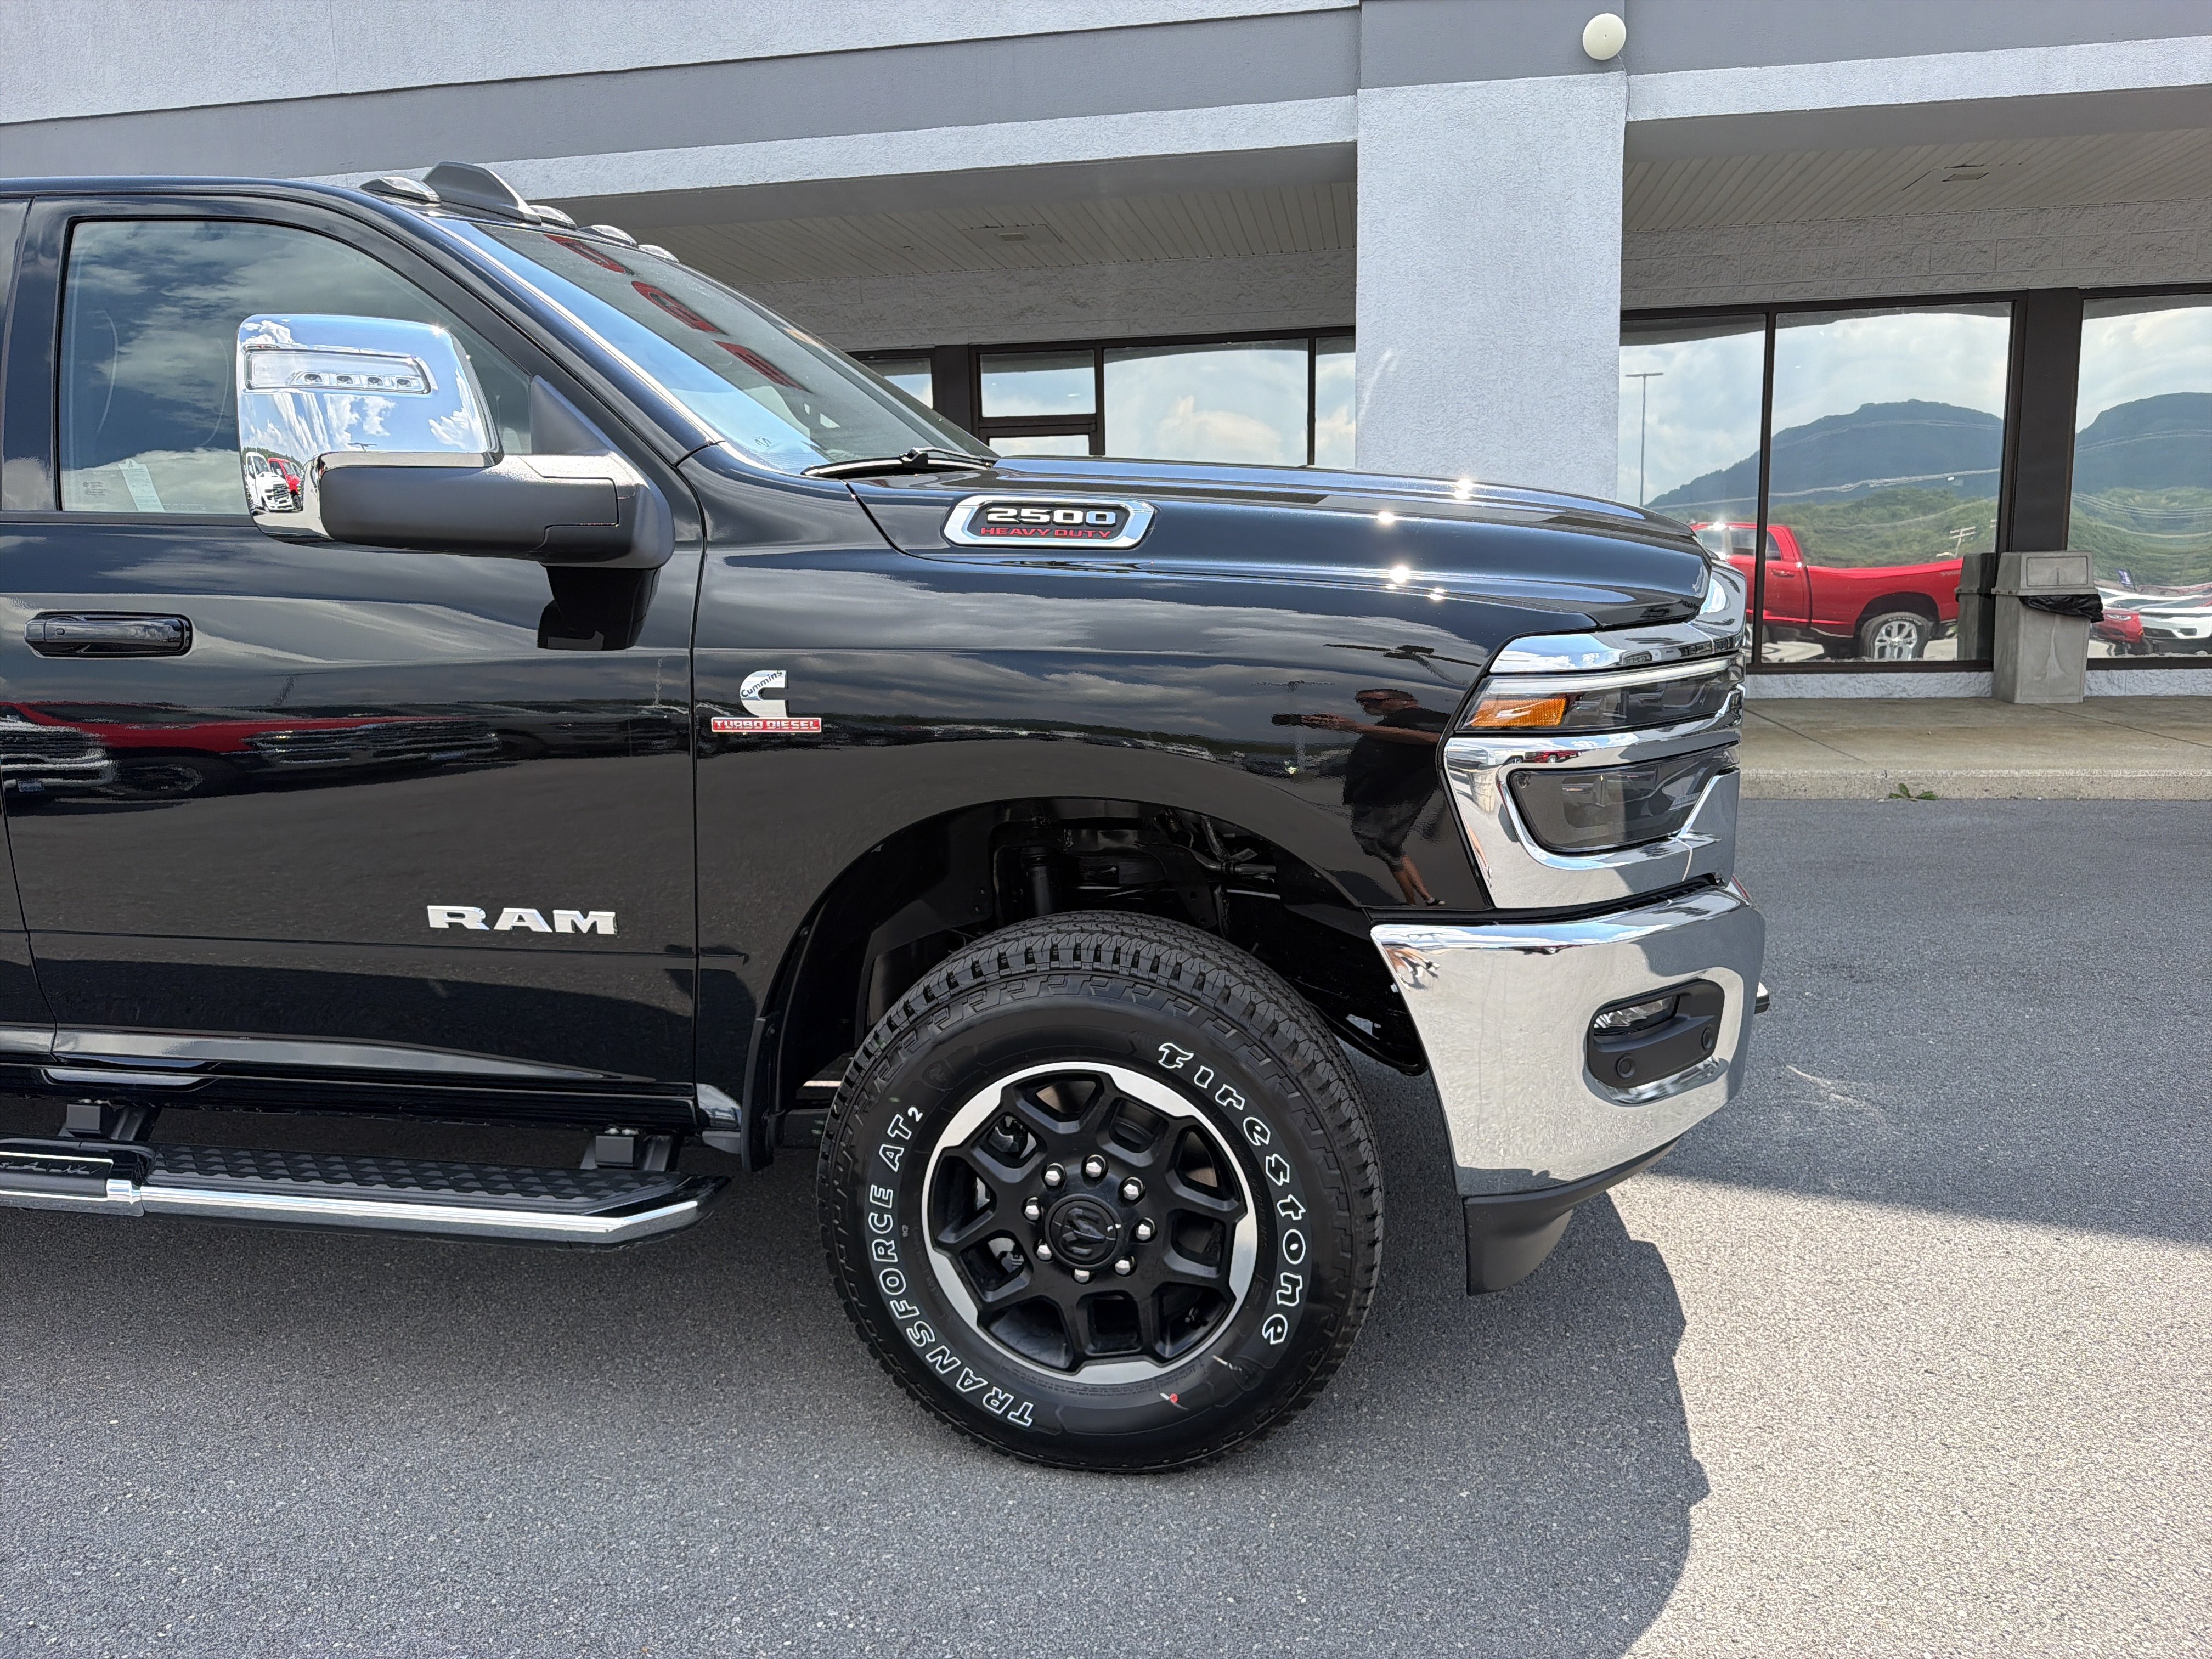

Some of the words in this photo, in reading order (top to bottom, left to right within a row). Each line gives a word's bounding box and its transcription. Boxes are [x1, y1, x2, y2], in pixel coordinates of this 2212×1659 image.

[986, 507, 1117, 526] 2500
[980, 527, 1051, 537] HEAVY
[1054, 529, 1113, 539] DUTY
[741, 669, 783, 698] Cummins
[714, 720, 763, 730] TURBO
[766, 720, 820, 730] DIESEL
[427, 905, 618, 935] RAM
[1158, 1041, 1306, 1345] Firestone
[868, 1183, 1035, 1426] TRANSFORCE
